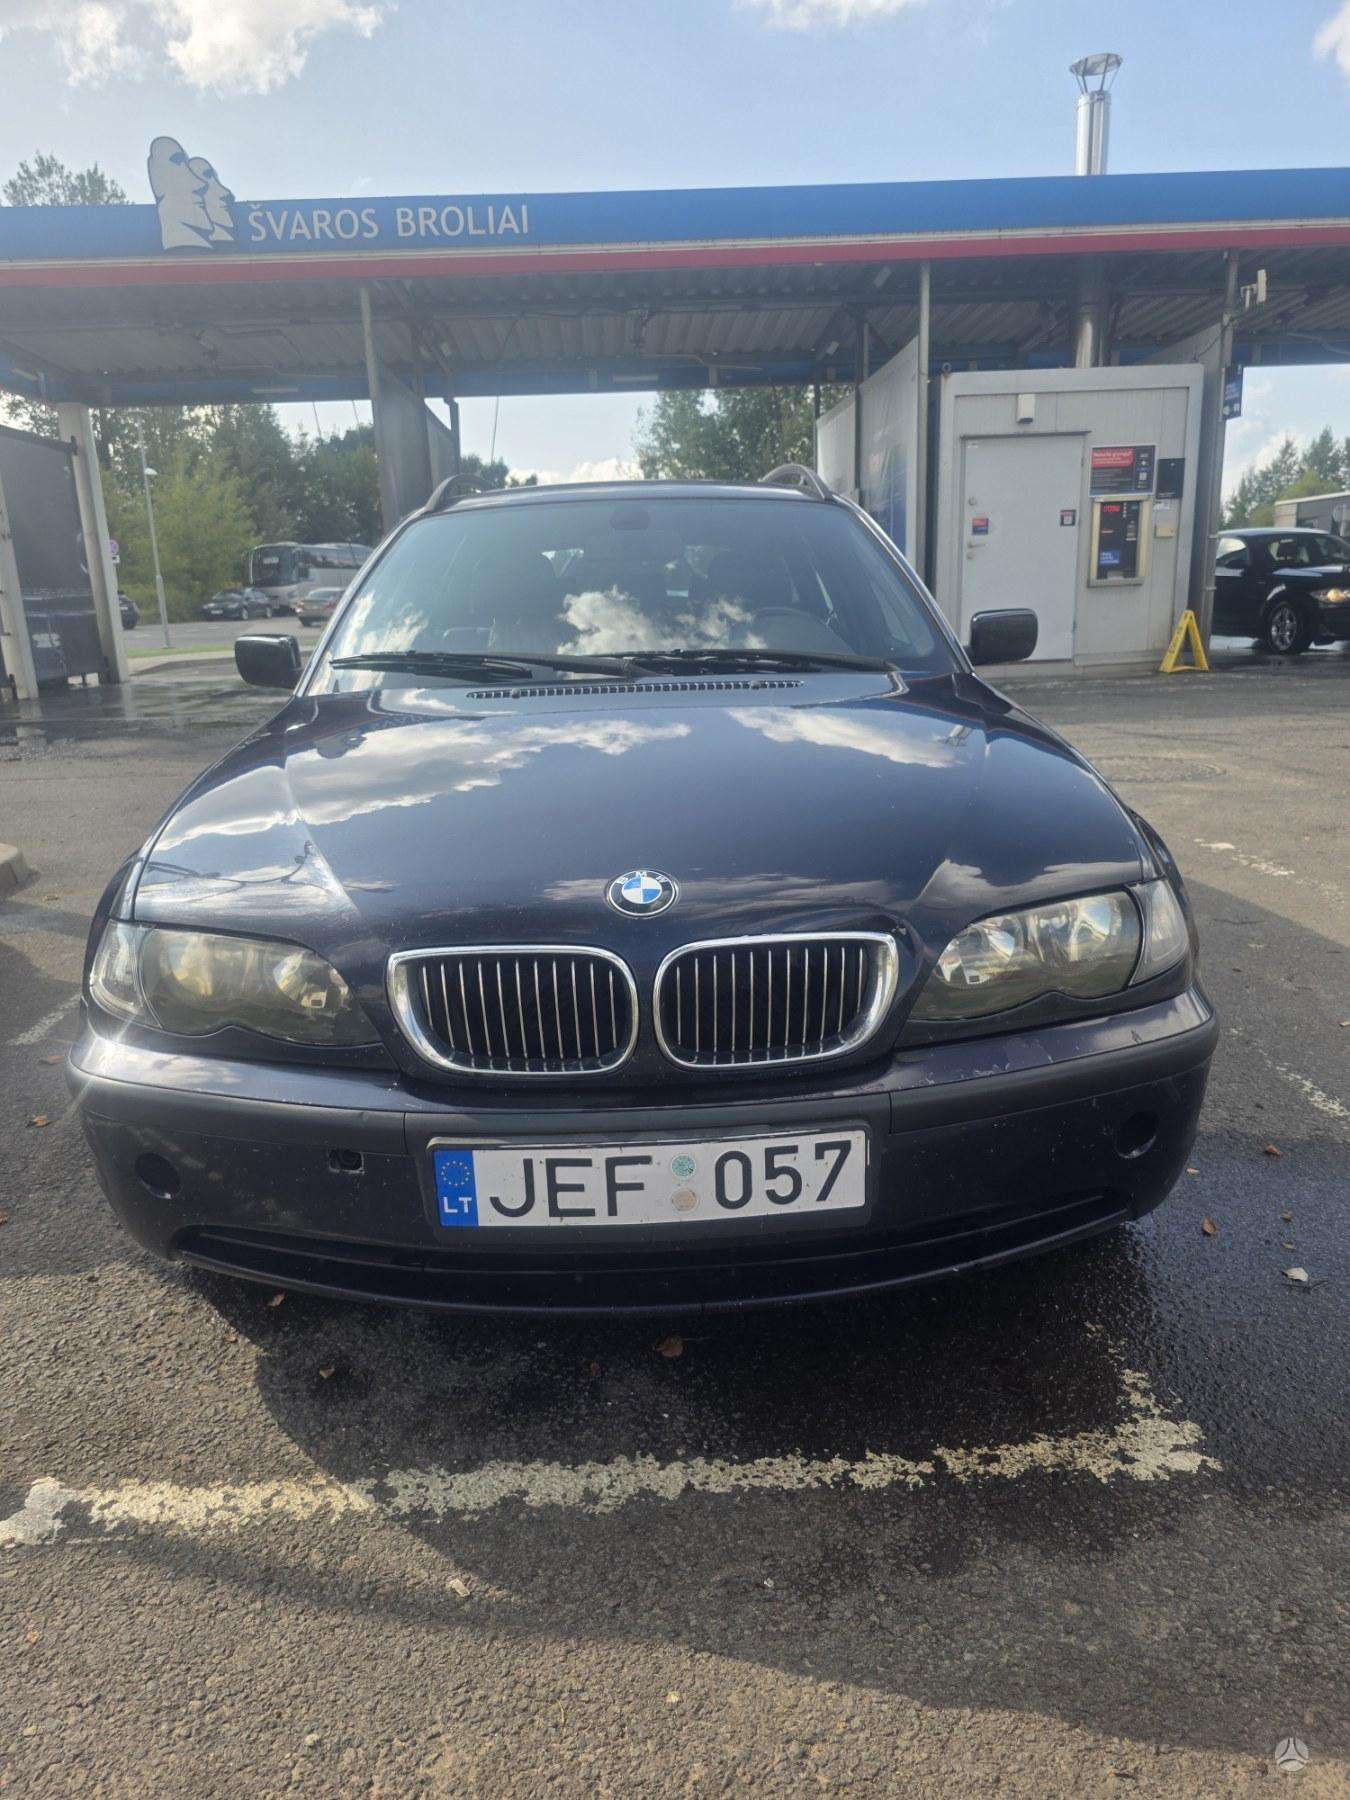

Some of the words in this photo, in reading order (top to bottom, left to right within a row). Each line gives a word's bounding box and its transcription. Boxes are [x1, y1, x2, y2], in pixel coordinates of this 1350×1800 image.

[248, 203, 380, 242] ŠVAROS
[396, 204, 529, 237] BROLIAI
[614, 870, 669, 885] BMW
[489, 1155, 653, 1218] JEF
[715, 1140, 852, 1210] 057
[442, 1196, 473, 1214] LT
